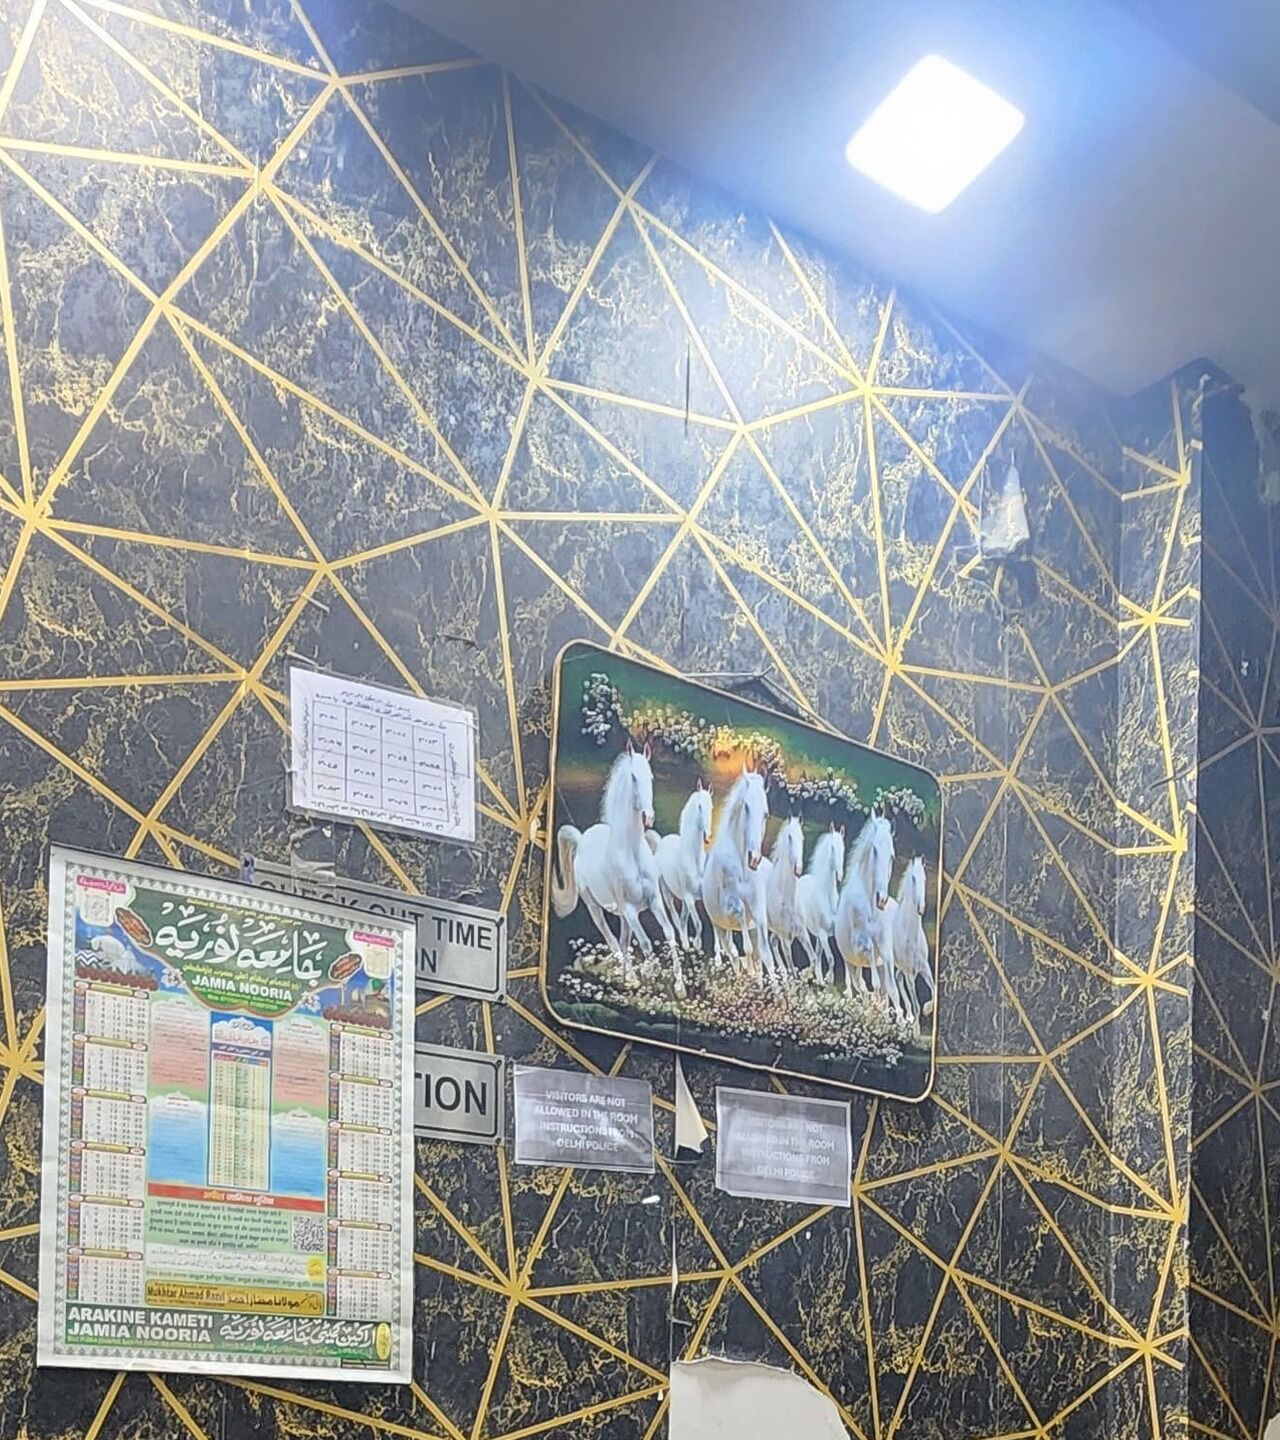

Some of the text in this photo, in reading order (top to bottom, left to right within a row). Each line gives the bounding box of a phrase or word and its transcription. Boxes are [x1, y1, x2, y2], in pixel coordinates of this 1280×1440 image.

[432, 916, 493, 951] TIME
[192, 974, 236, 992] JAMIA
[239, 982, 293, 1002] NOORIA
[545, 1089, 626, 1108] VISITORS ARE NOT
[534, 1105, 580, 1119] ALLOWED
[580, 1109, 591, 1119] IN
[609, 1112, 639, 1125] ROOM
[806, 1121, 823, 1133] NOT
[556, 1137, 585, 1150] DELHI
[808, 1138, 835, 1152] ROOM
[805, 1153, 831, 1167] FROM
[68, 1306, 213, 1329] ARAKINE KAMETI
[67, 1321, 212, 1343] JAMIA NOORIA
